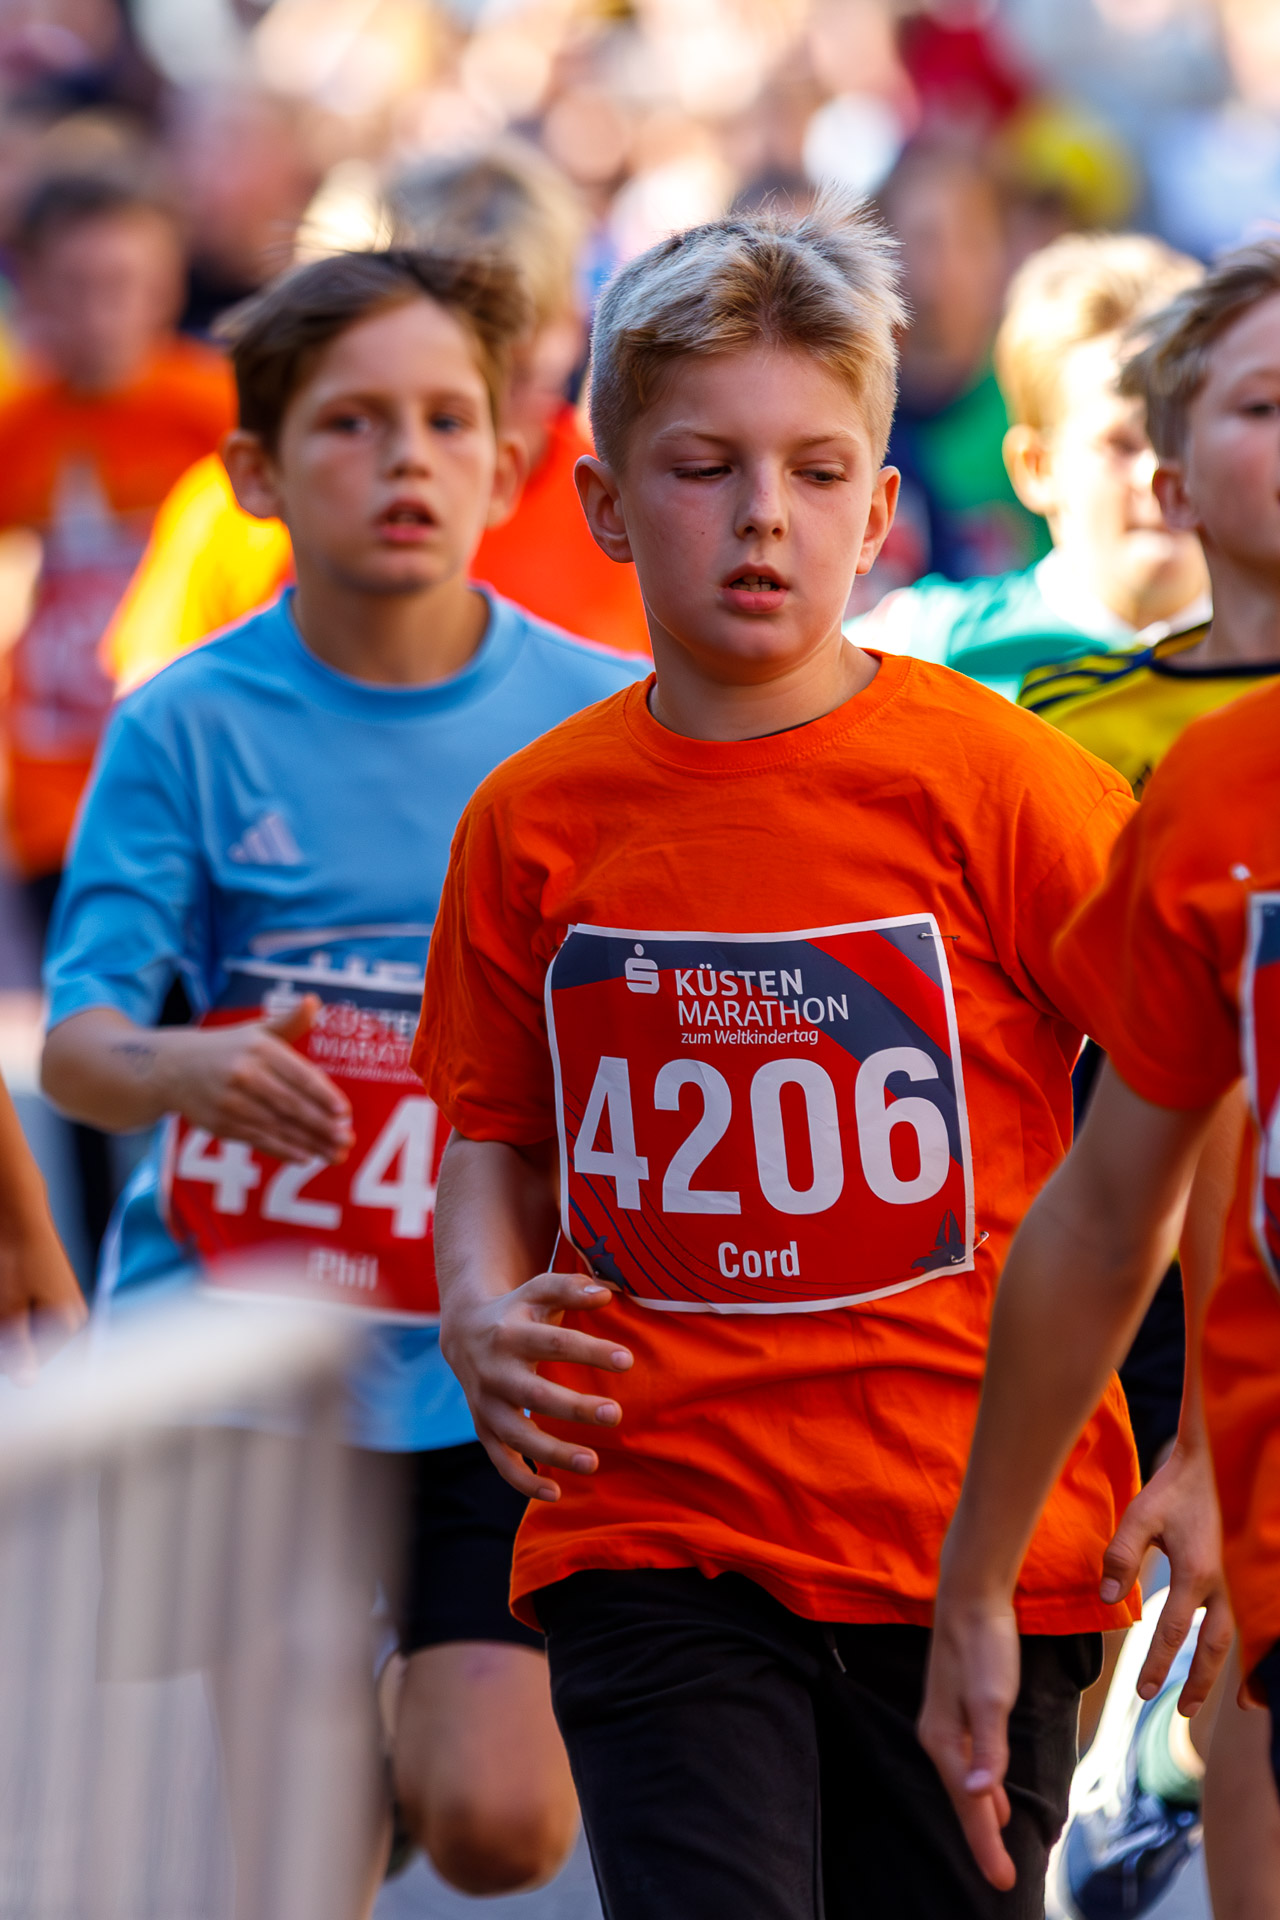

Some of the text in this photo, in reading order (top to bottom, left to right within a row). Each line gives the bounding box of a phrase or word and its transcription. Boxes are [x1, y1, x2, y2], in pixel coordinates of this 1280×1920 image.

[674, 963, 804, 997] KÜSTEN
[677, 994, 850, 1027] MARATHON
[680, 1029, 819, 1046] zum Weltkindertag
[573, 1046, 951, 1215] 4206
[716, 1240, 801, 1279] Cord
